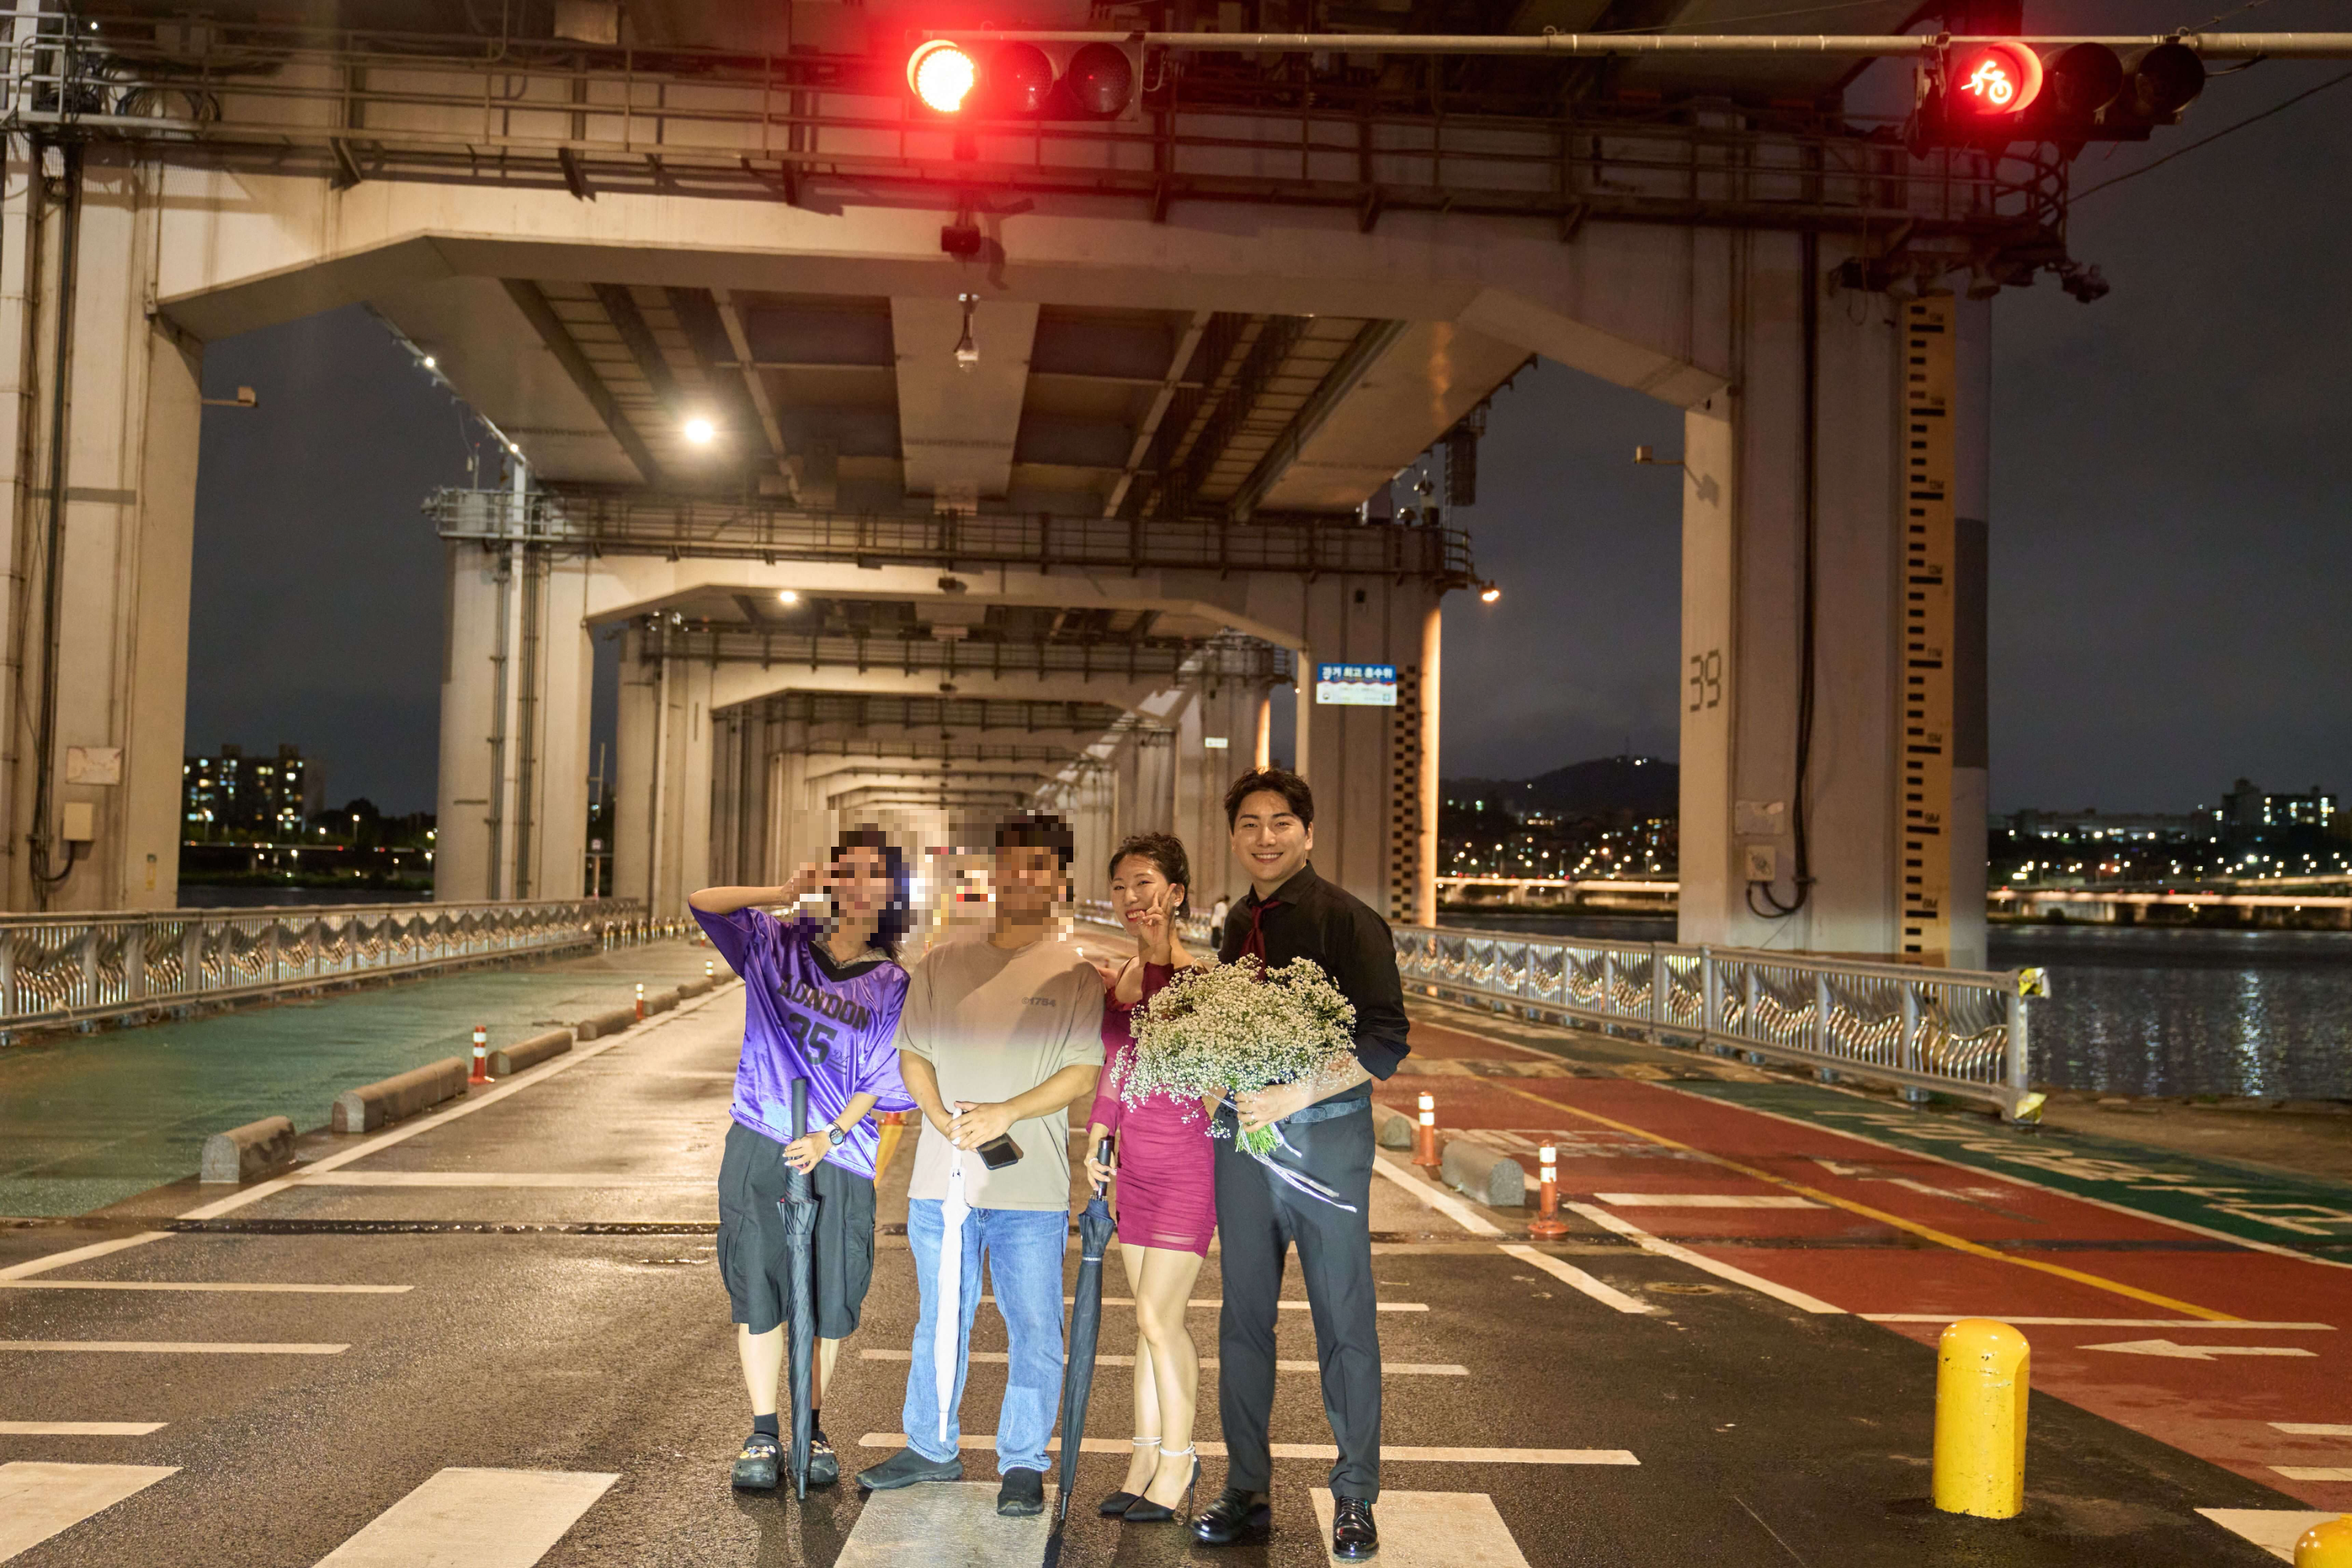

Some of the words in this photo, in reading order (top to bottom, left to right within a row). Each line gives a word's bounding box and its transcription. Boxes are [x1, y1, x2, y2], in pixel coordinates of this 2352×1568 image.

[1343, 666, 1363, 677] 최고
[1364, 666, 1393, 678] 홍수위
[1690, 648, 1722, 713] 39
[777, 974, 870, 1033] LONDON
[788, 1012, 838, 1065] 35
